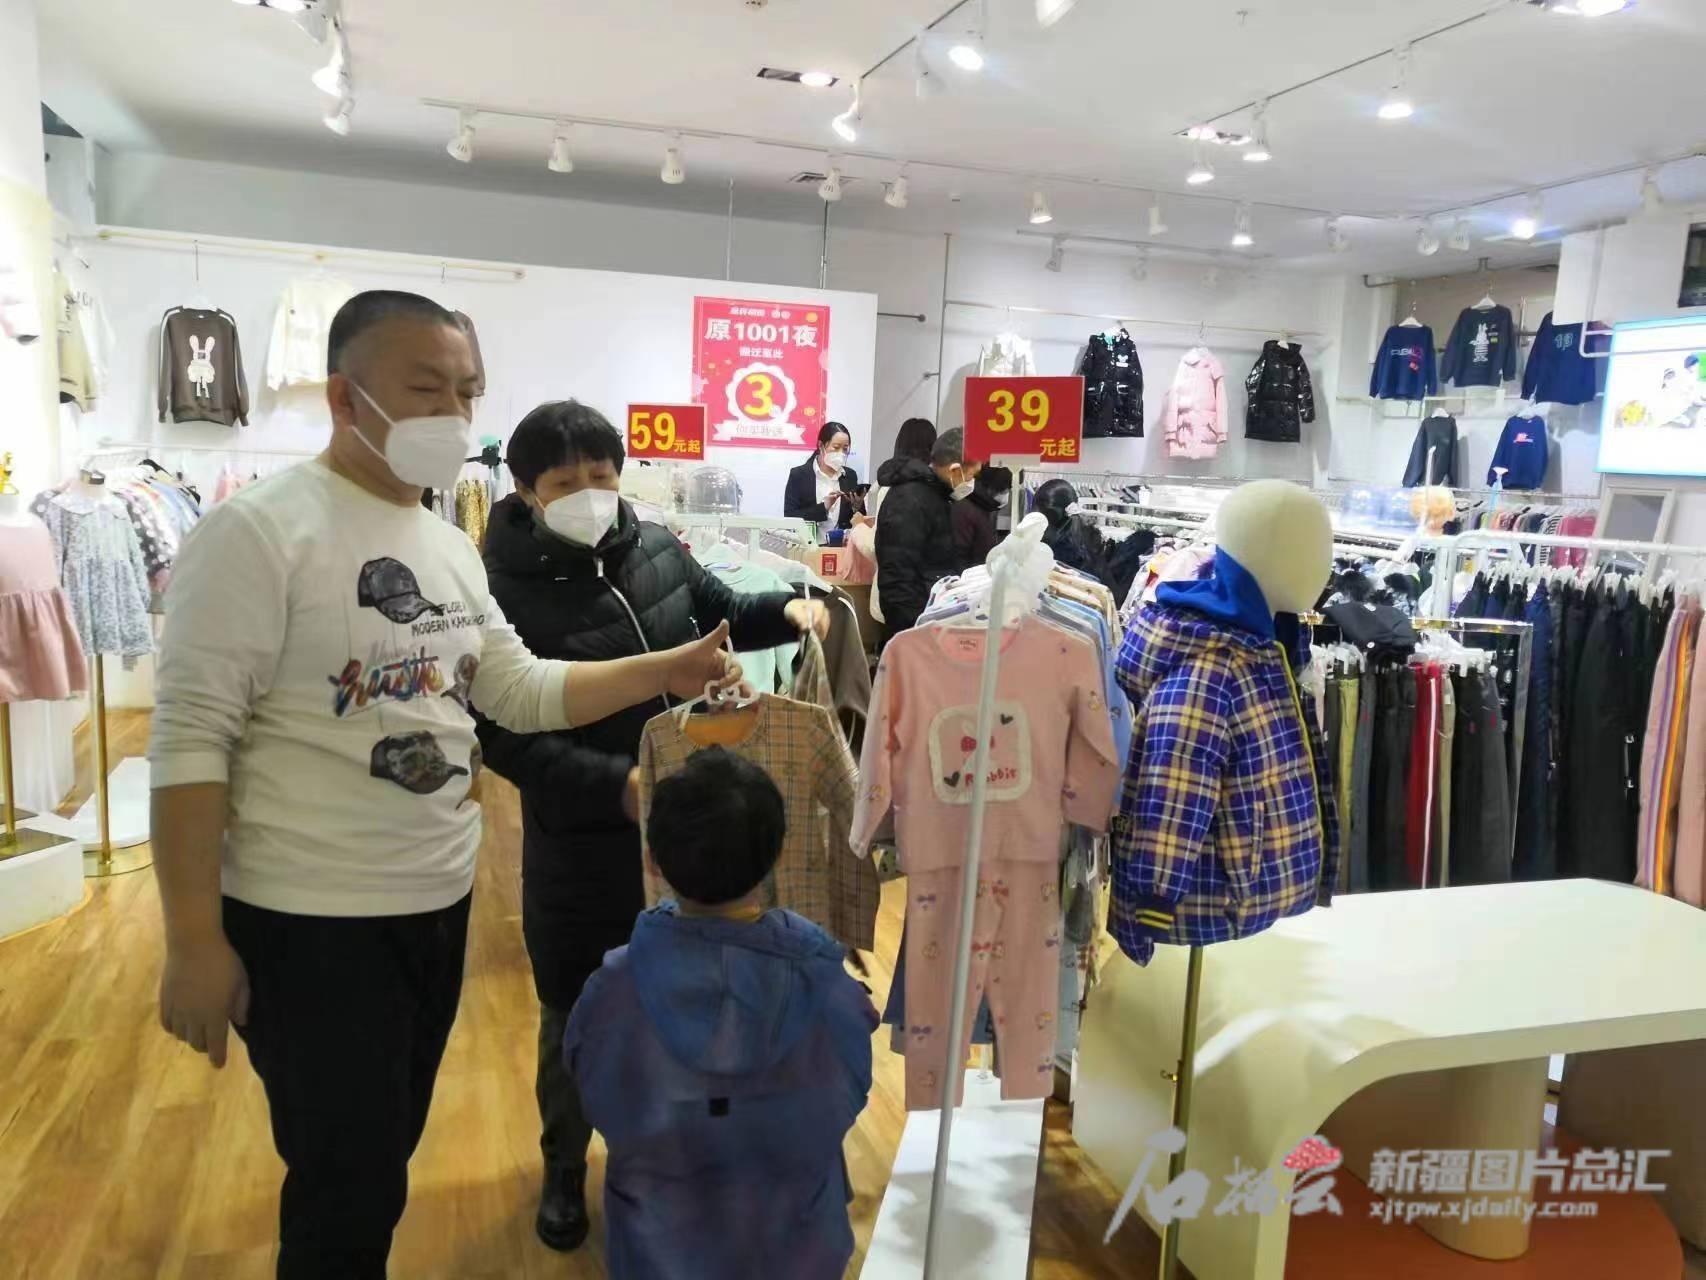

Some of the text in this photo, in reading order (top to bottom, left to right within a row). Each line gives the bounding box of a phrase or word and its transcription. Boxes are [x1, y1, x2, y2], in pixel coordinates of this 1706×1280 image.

[705, 318, 818, 348] 原1001夜
[744, 373, 773, 416] 3
[987, 389, 1050, 432] 39
[631, 412, 701, 453] 59 元起
[1040, 438, 1077, 457] 元起
[411, 618, 450, 637] MODERN
[965, 766, 1017, 788] Rbbit
